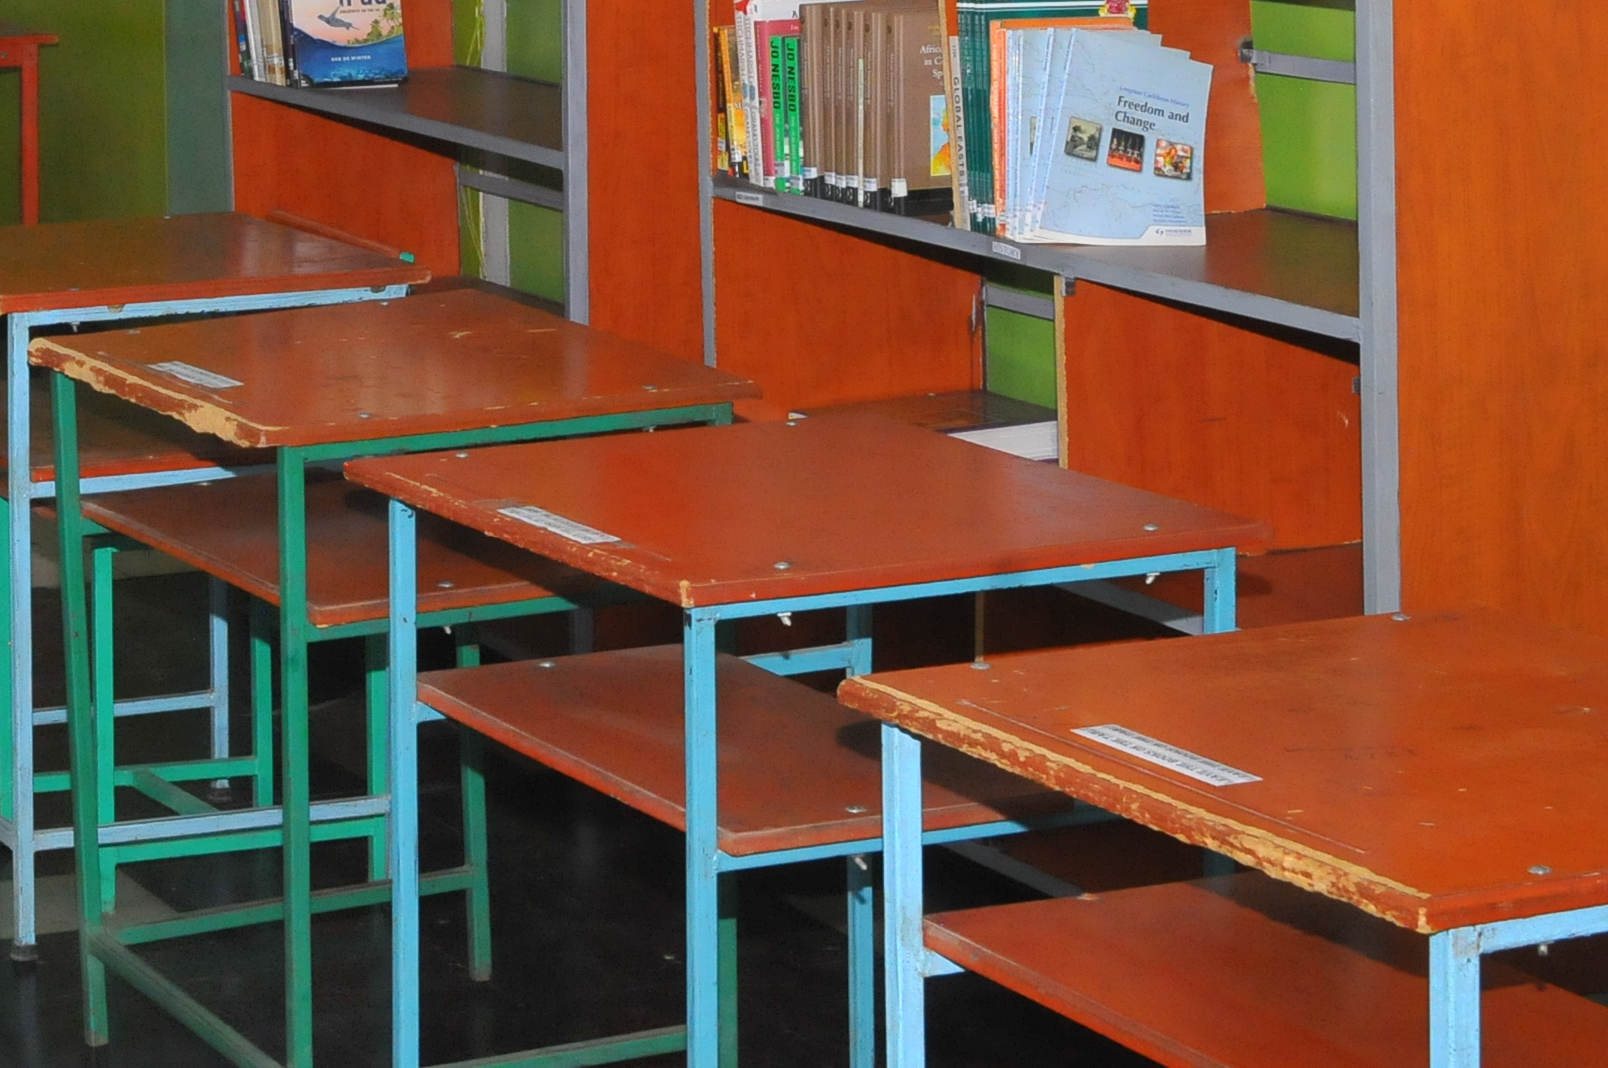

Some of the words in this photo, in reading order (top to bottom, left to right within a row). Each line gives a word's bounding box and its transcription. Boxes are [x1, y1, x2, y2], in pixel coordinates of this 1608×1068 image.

[770, 40, 780, 59] JO
[786, 43, 795, 62] JO
[924, 57, 933, 65] in
[954, 77, 962, 130] GLOBAL
[1117, 95, 1165, 118] Freedom
[1168, 111, 1190, 124] and
[1114, 110, 1156, 132] Change
[993, 243, 1020, 258] HISTORY
